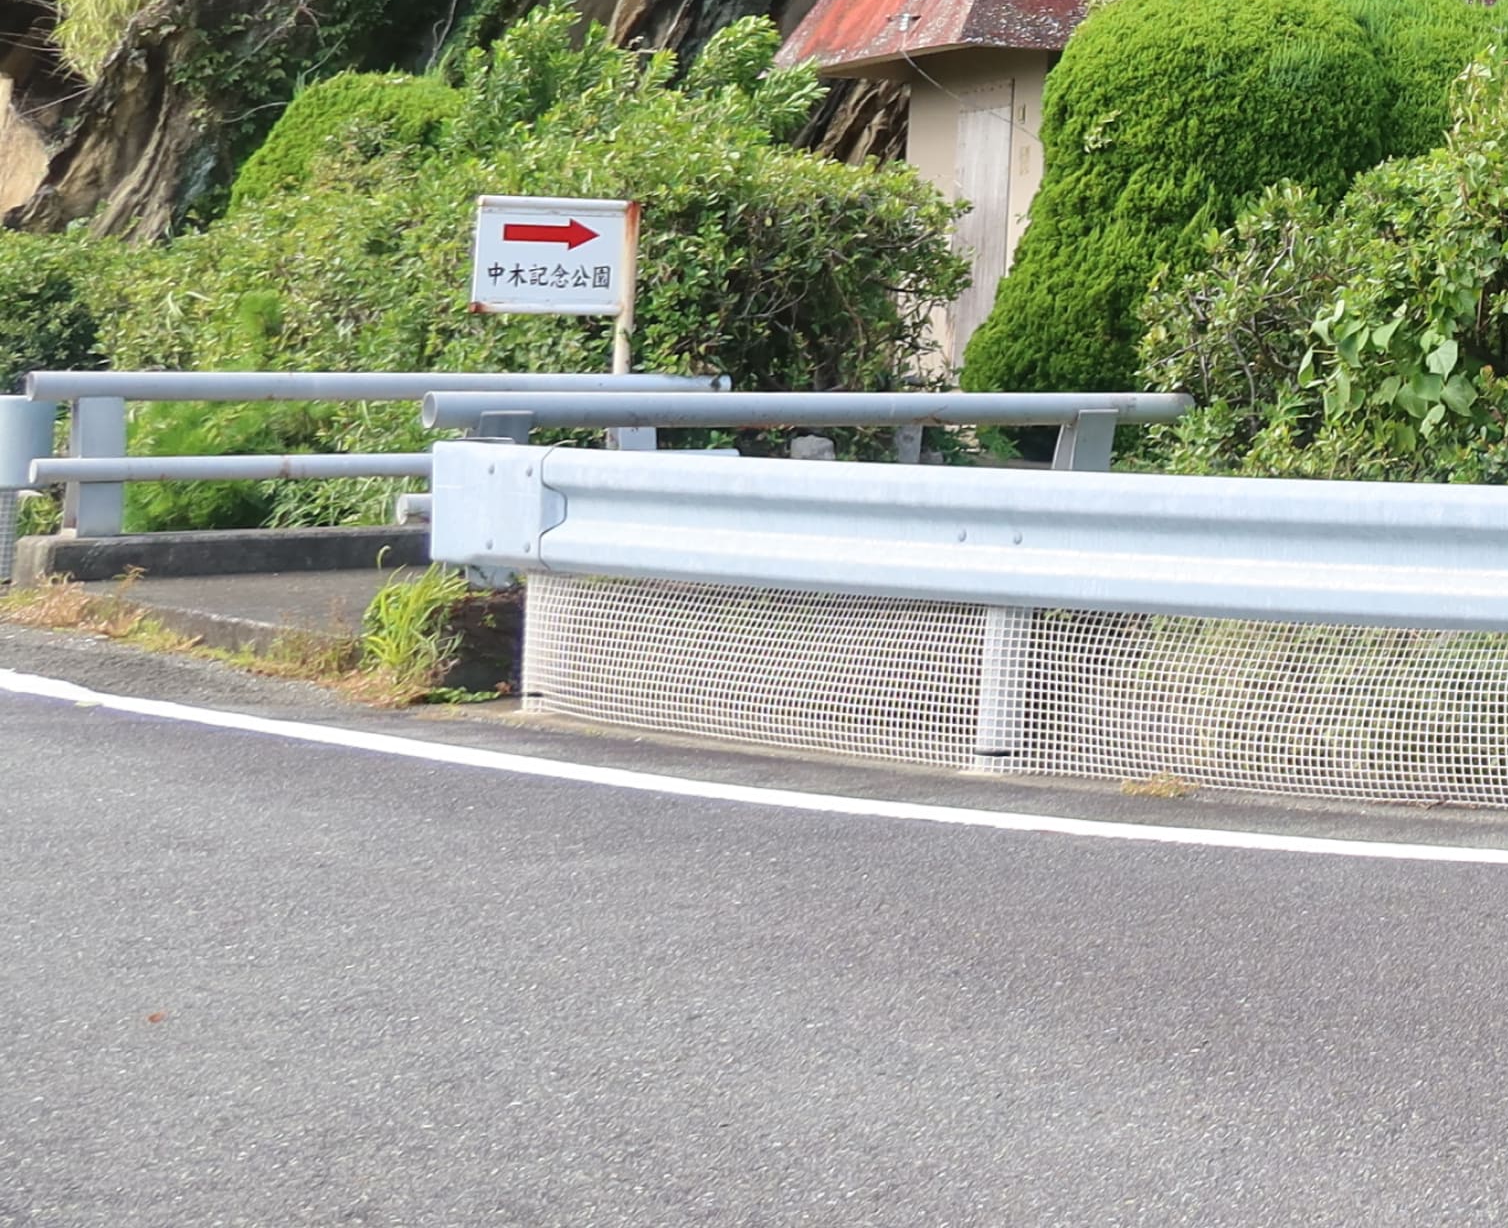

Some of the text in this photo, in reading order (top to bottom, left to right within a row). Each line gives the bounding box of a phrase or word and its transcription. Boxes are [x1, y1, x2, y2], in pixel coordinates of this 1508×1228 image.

[487, 261, 611, 289] 中木記念公園
